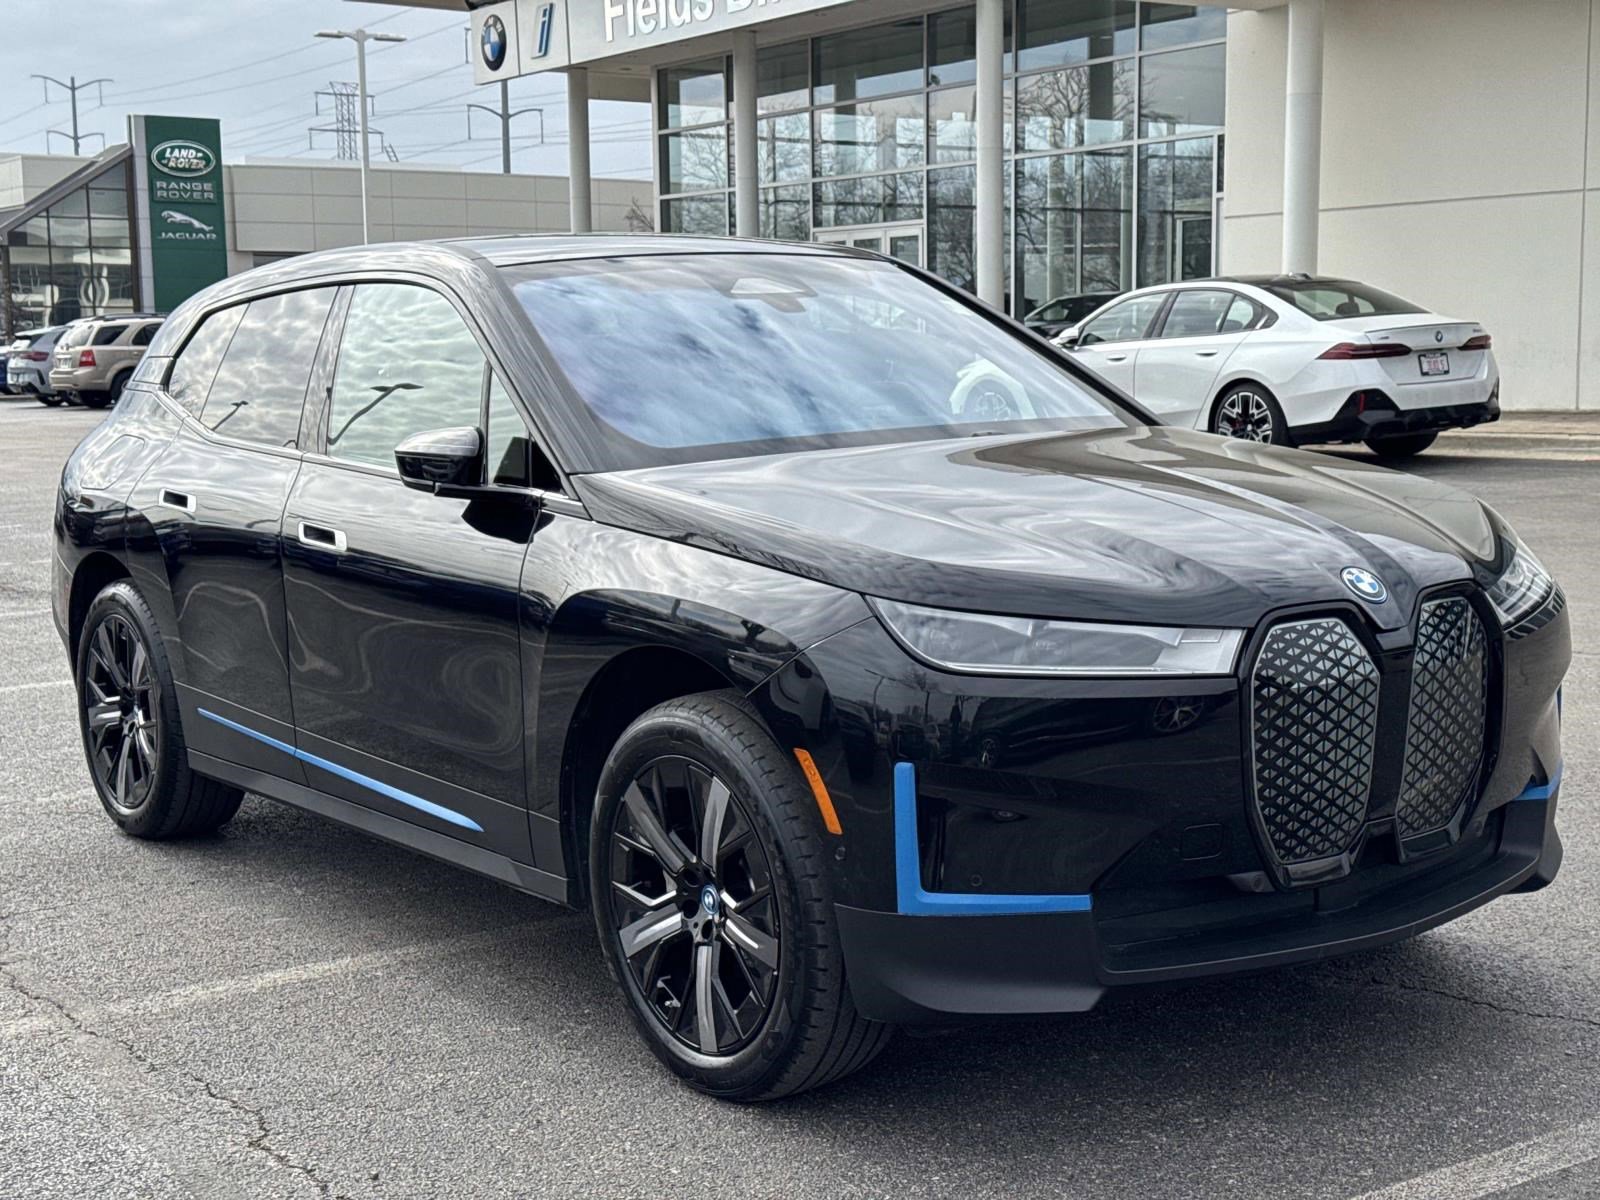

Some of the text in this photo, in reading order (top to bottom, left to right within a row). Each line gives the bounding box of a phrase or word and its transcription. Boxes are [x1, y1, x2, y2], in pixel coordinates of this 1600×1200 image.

[156, 181, 212, 190] RANGE
[157, 190, 214, 199] ROVER
[157, 232, 217, 240] JAGUAR
